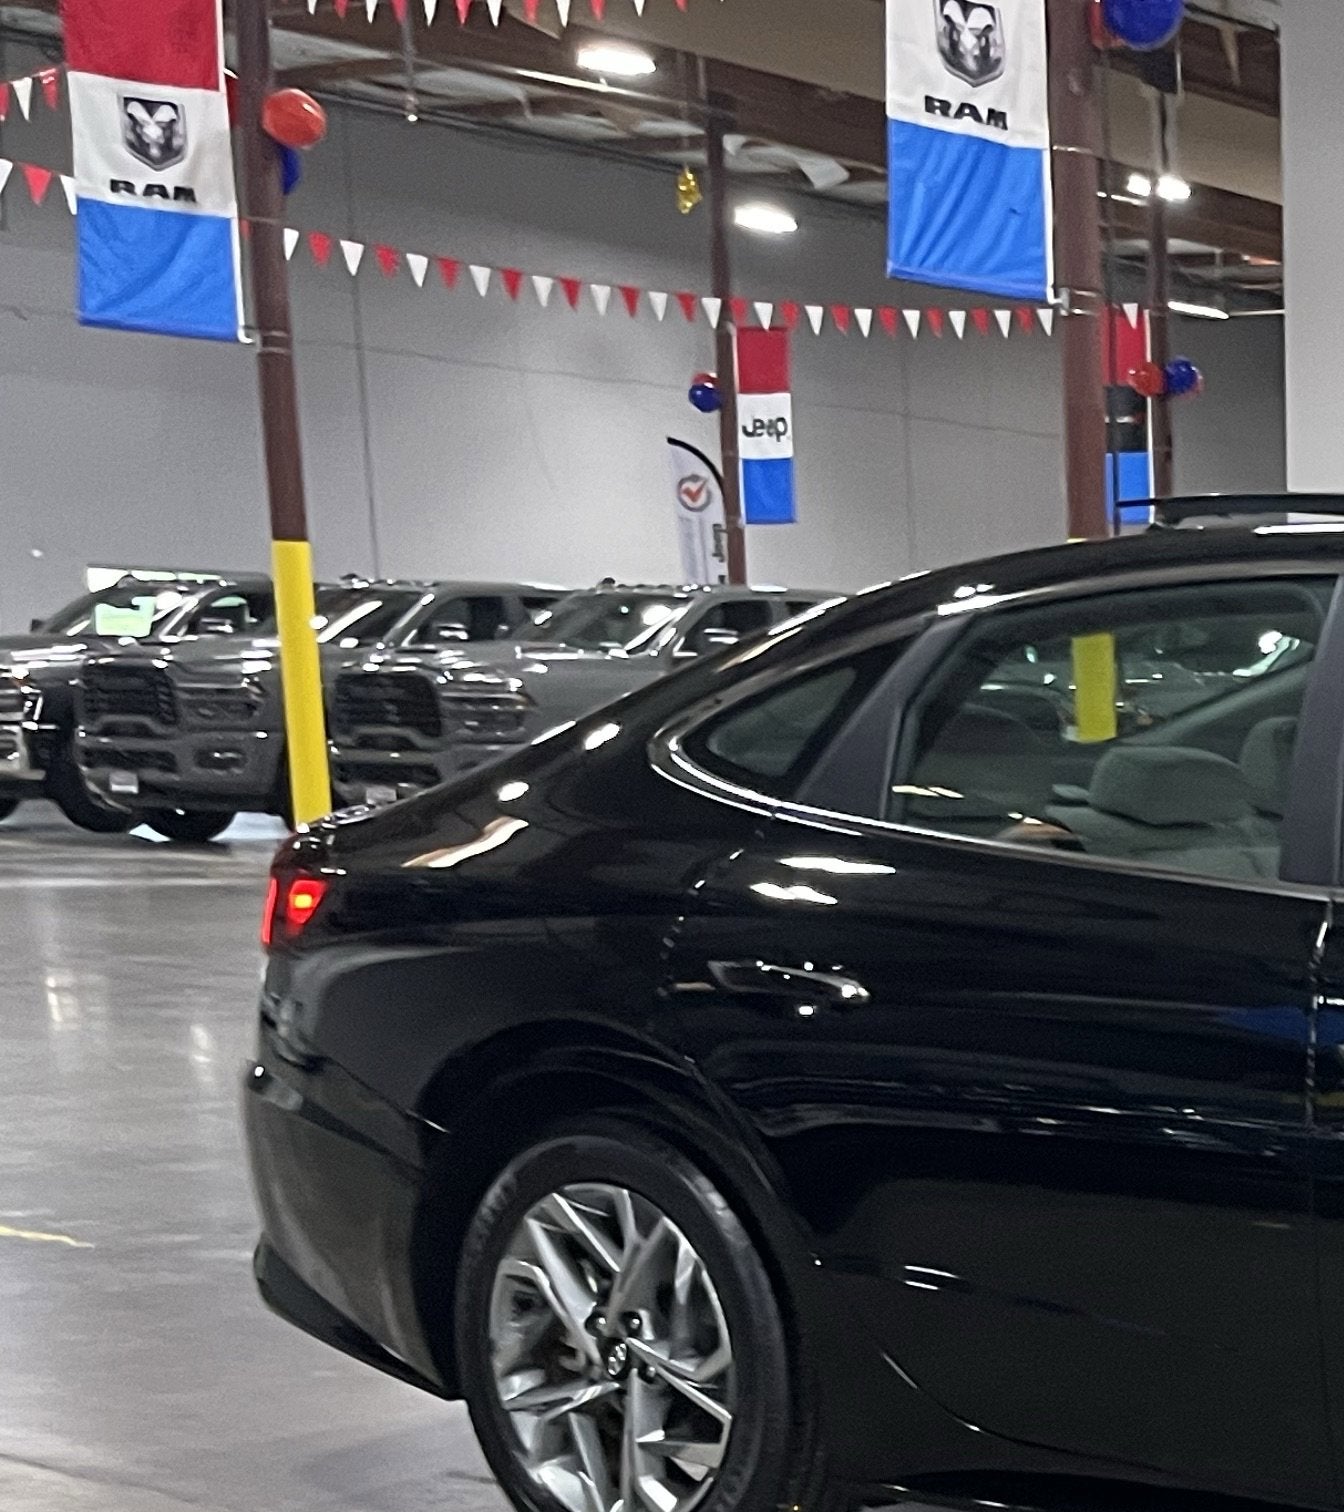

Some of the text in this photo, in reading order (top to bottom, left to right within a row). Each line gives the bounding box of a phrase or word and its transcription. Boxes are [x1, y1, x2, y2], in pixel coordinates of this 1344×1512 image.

[924, 94, 1008, 131] RAM
[110, 178, 198, 203] RAM
[742, 416, 788, 443] Jeep
